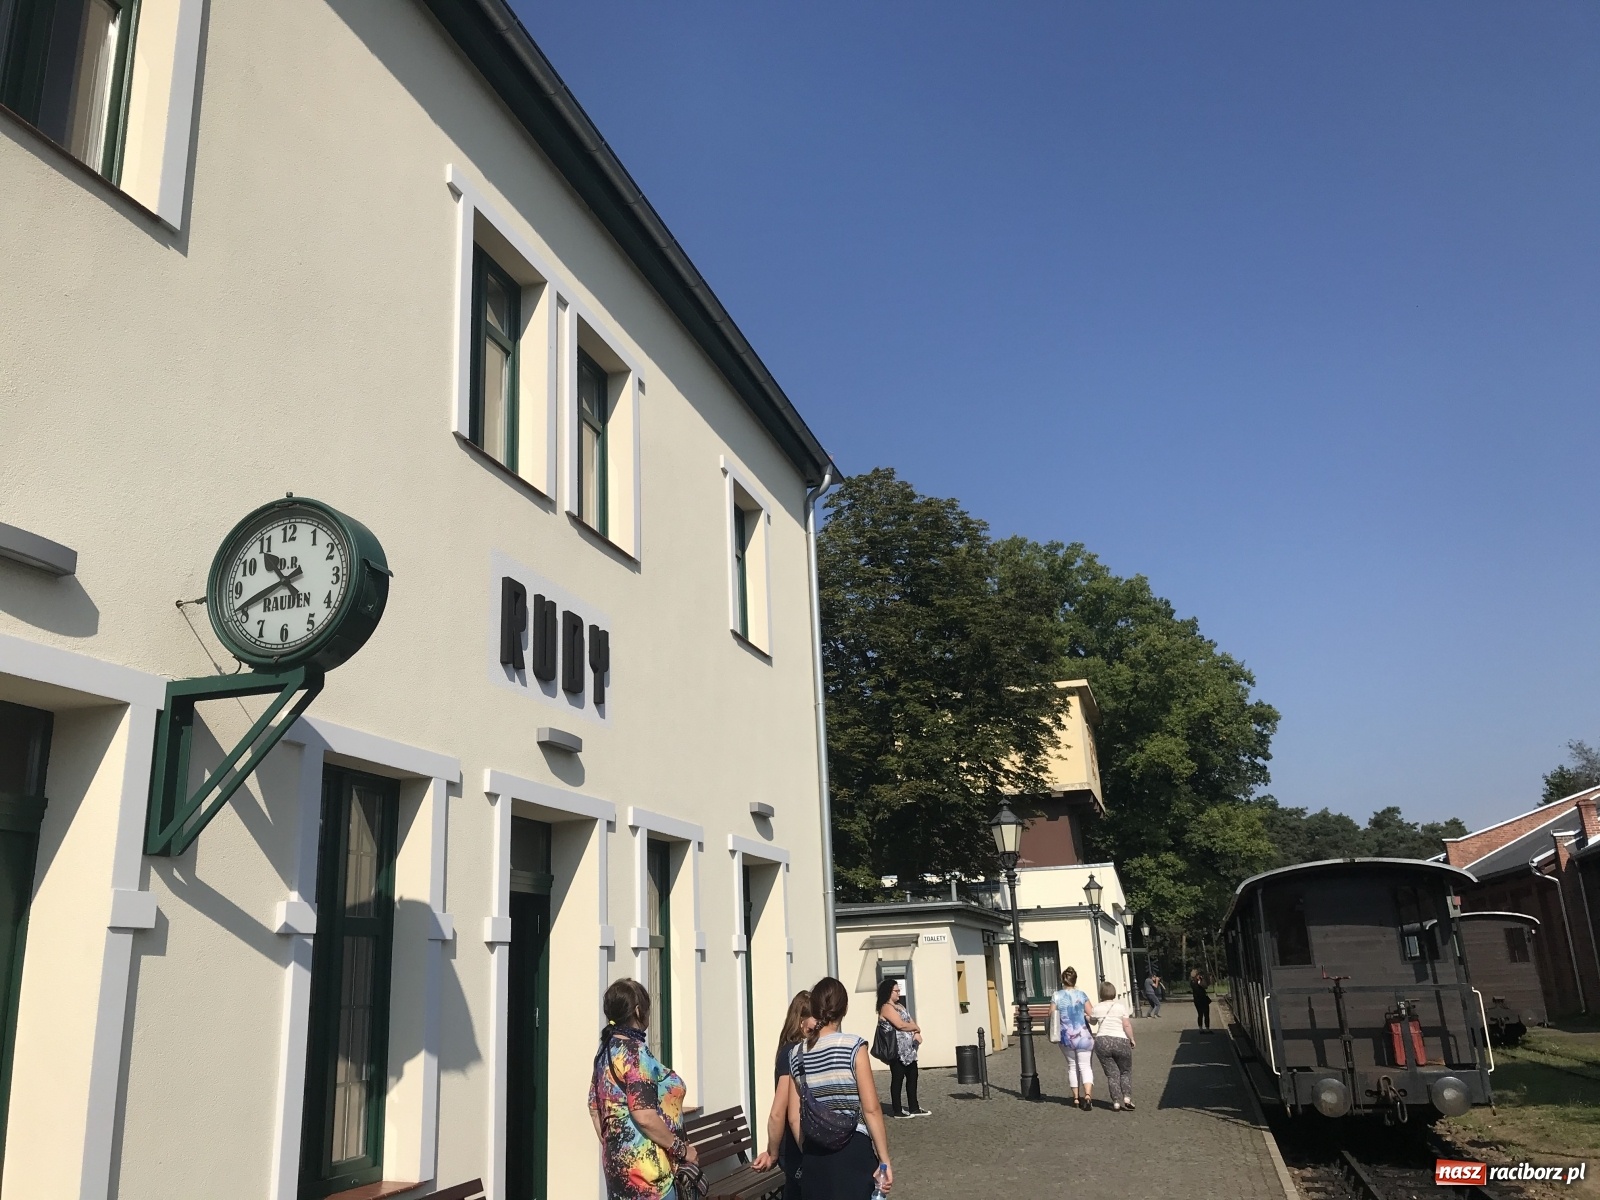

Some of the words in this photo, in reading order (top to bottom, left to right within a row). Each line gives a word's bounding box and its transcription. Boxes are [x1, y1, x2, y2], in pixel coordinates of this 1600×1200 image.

[281, 524, 298, 543] 12
[310, 528, 317, 546] 1
[259, 534, 272, 554] 11
[325, 542, 335, 561] 2
[241, 557, 257, 577] 10
[331, 566, 340, 585] 3
[235, 581, 243, 599] 9
[323, 590, 332, 609] 4
[263, 592, 311, 612] RAUDEN
[241, 604, 249, 623] 8
[306, 613, 316, 632] 5
[257, 619, 266, 638] 7
[280, 623, 289, 642] 6
[500, 576, 610, 704] RUDY
